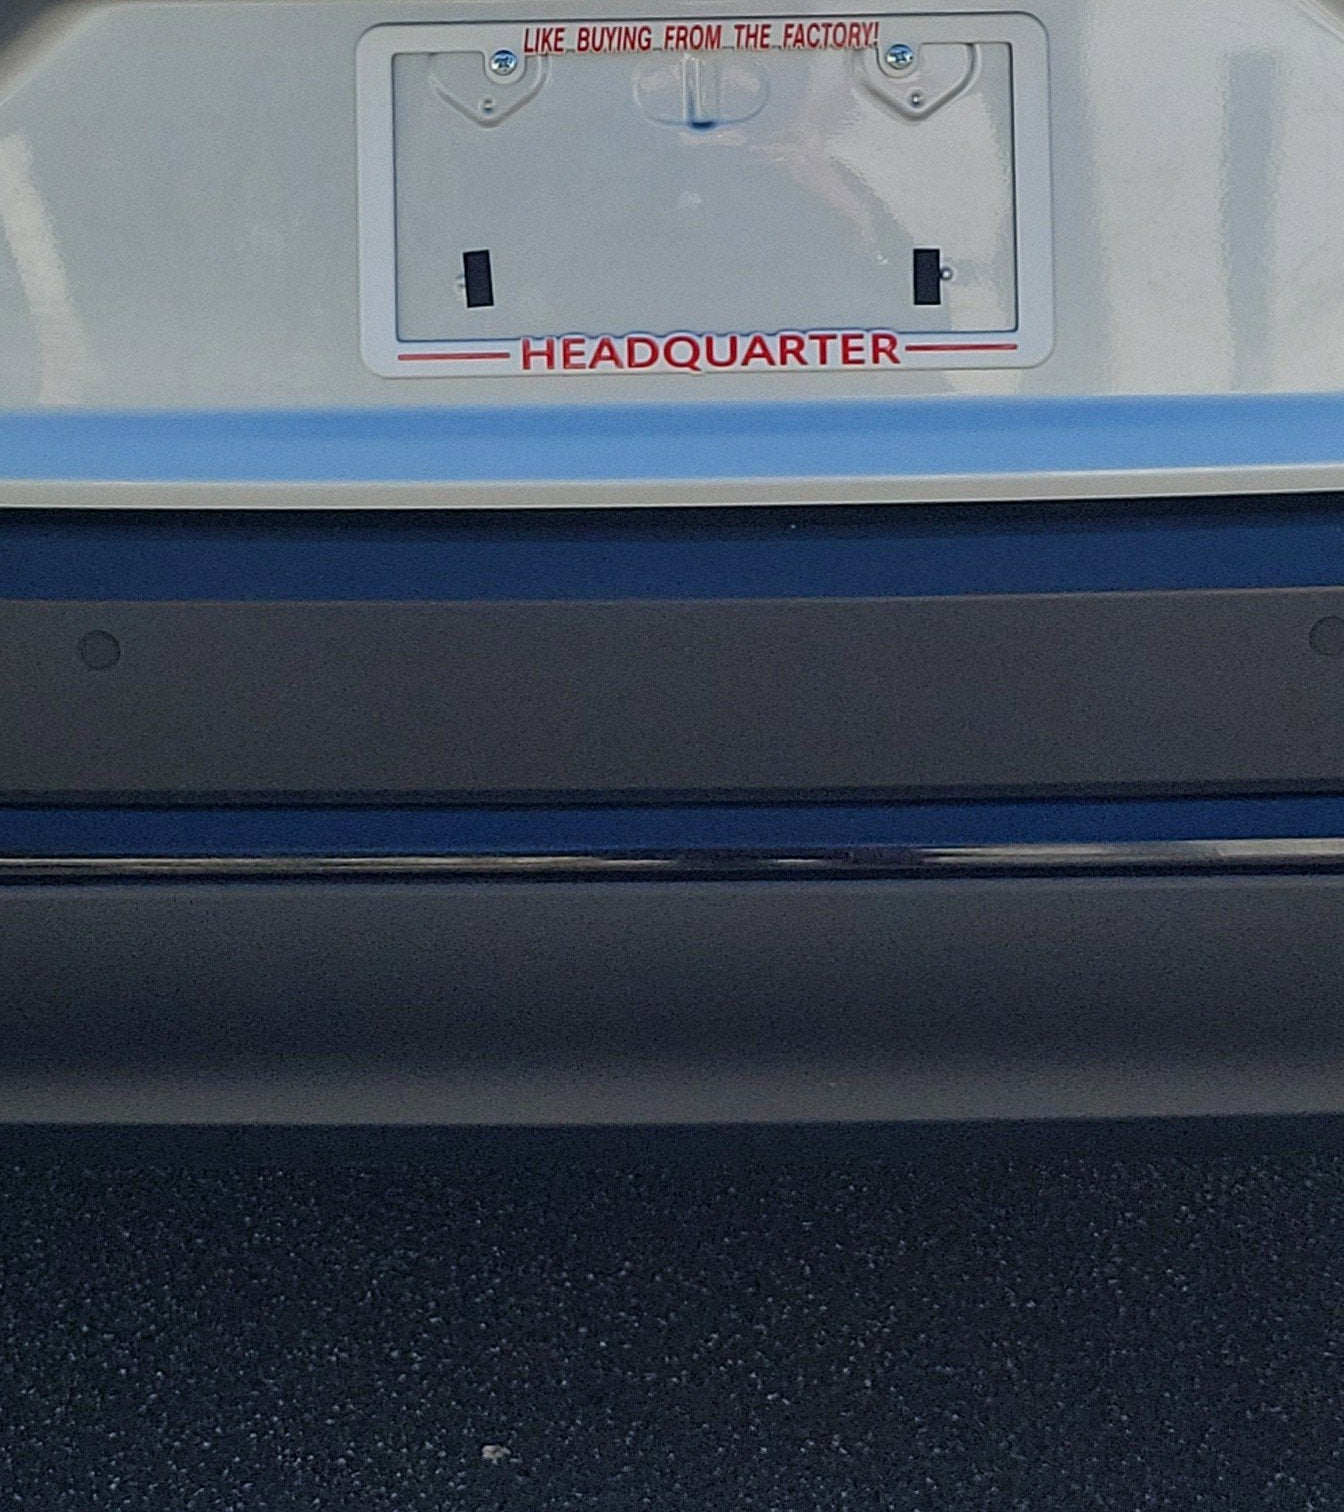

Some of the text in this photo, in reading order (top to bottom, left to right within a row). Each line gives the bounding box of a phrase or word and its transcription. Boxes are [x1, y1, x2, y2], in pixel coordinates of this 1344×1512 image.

[524, 21, 879, 53] LIKE BUYING FROM THE FACTORY!
[521, 333, 901, 372] HEADQUARTER
